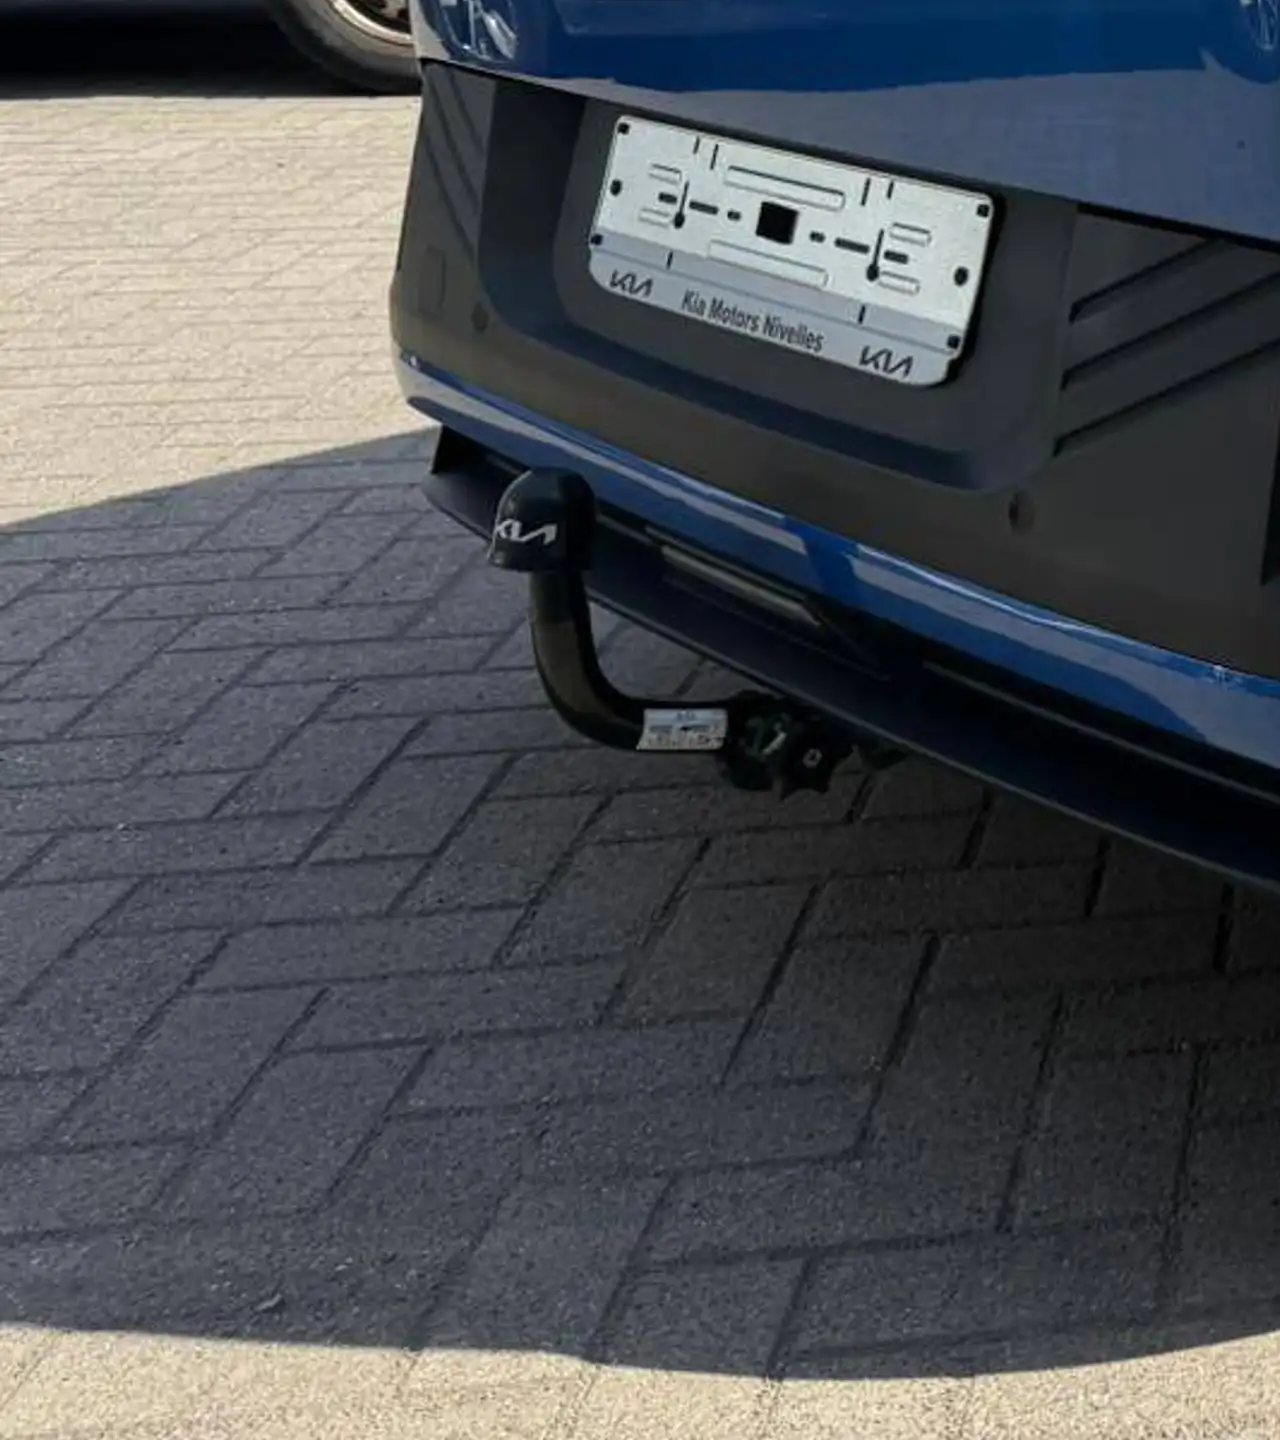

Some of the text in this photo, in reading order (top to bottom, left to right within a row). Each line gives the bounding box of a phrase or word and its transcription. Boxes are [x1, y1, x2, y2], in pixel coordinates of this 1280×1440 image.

[610, 268, 653, 297] KIA
[682, 290, 824, 352] Kia Motors Nivelles
[859, 344, 914, 377] KIA
